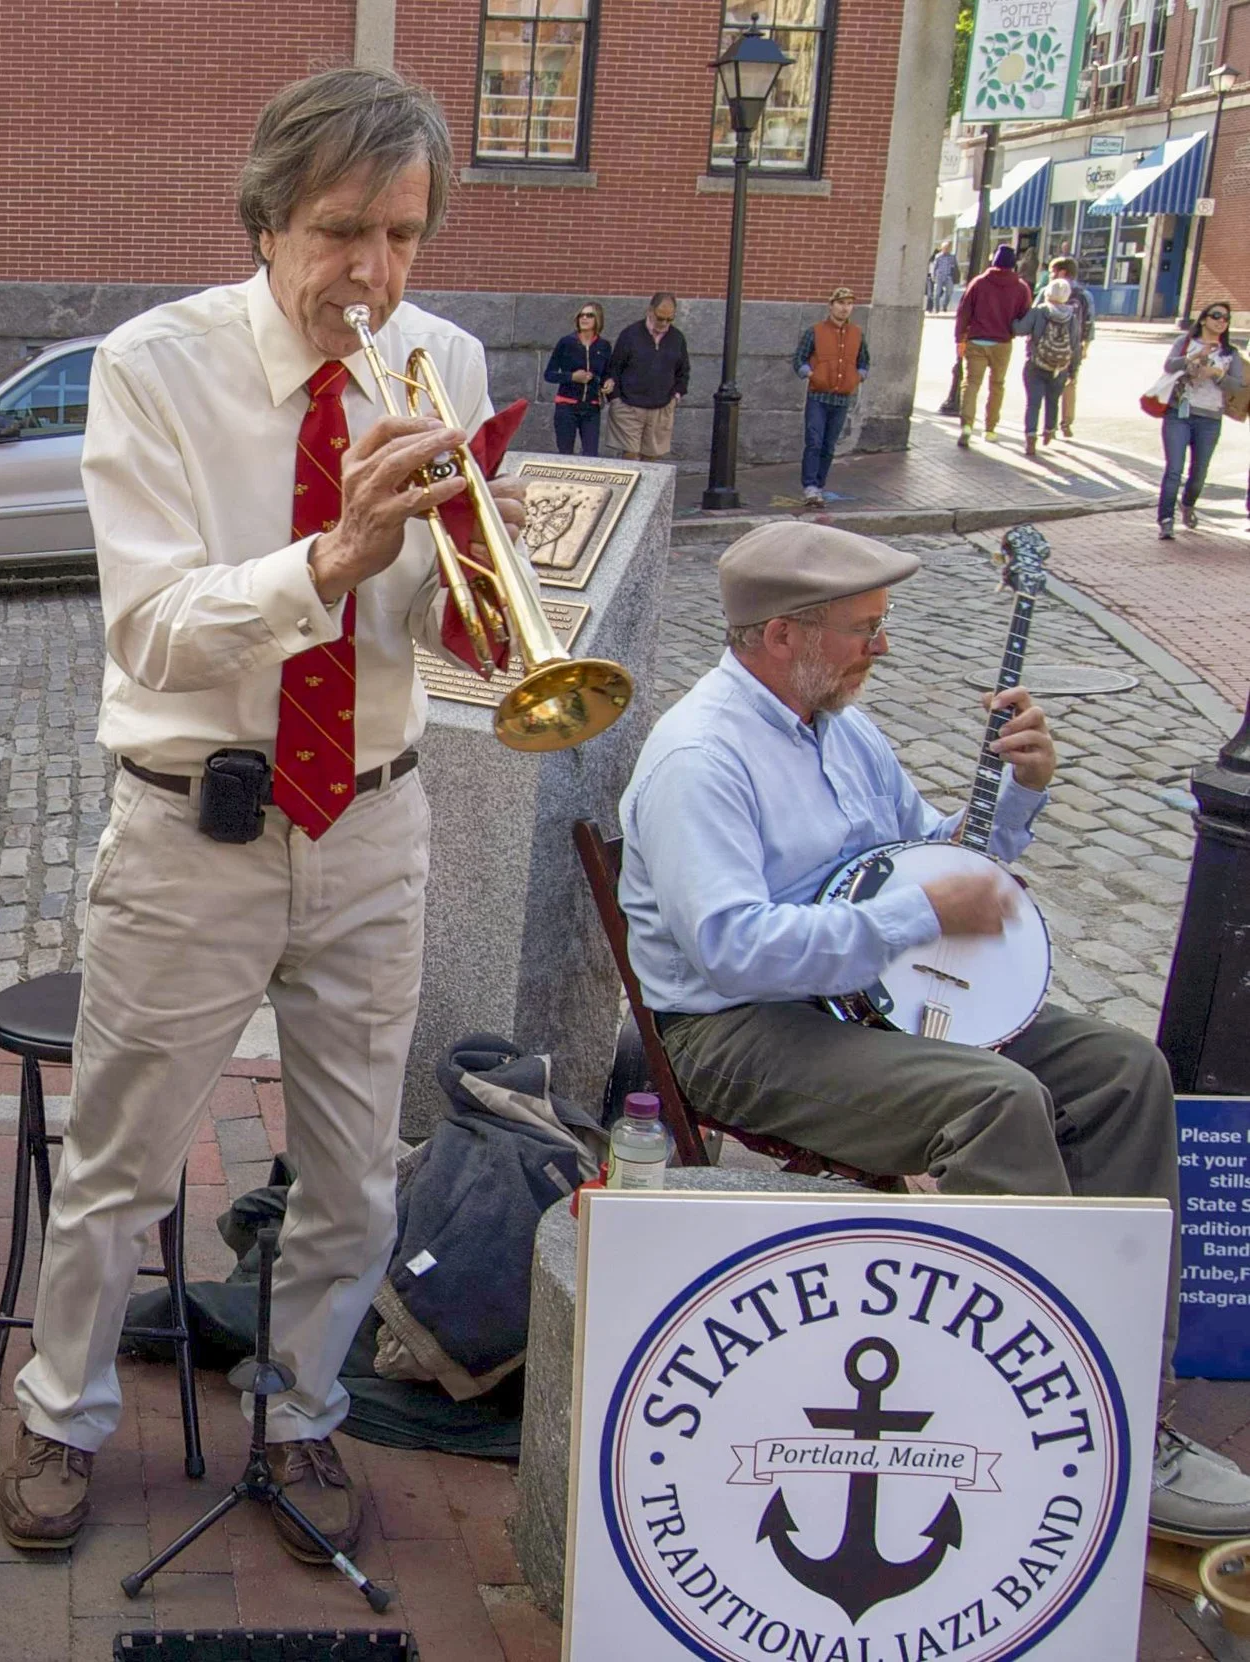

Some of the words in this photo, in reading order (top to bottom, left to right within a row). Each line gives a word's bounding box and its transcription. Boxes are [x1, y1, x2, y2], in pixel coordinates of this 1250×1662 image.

[1000, 1, 1057, 16] POTTERY
[1002, 13, 1051, 28] OUTLET
[524, 467, 564, 479] Portland
[565, 471, 606, 484] Freedom
[608, 475, 630, 486] Trail
[1180, 1128, 1242, 1143] Please
[1177, 1152, 1200, 1166] st
[1203, 1155, 1247, 1170] your
[1186, 1197, 1237, 1212] State
[1180, 1220, 1250, 1237] radition
[1203, 1242, 1250, 1257] Band
[1180, 1265, 1250, 1284] uTube,F
[1178, 1289, 1250, 1308] nstagra
[643, 1262, 839, 1440] STATE
[859, 1259, 1095, 1456] STREET
[767, 1442, 880, 1468] Portland,
[888, 1446, 965, 1469] Maine
[641, 1483, 872, 1662] TRADITIONAL
[894, 1598, 1001, 1662] JAZZ
[993, 1494, 1084, 1612] BAND
